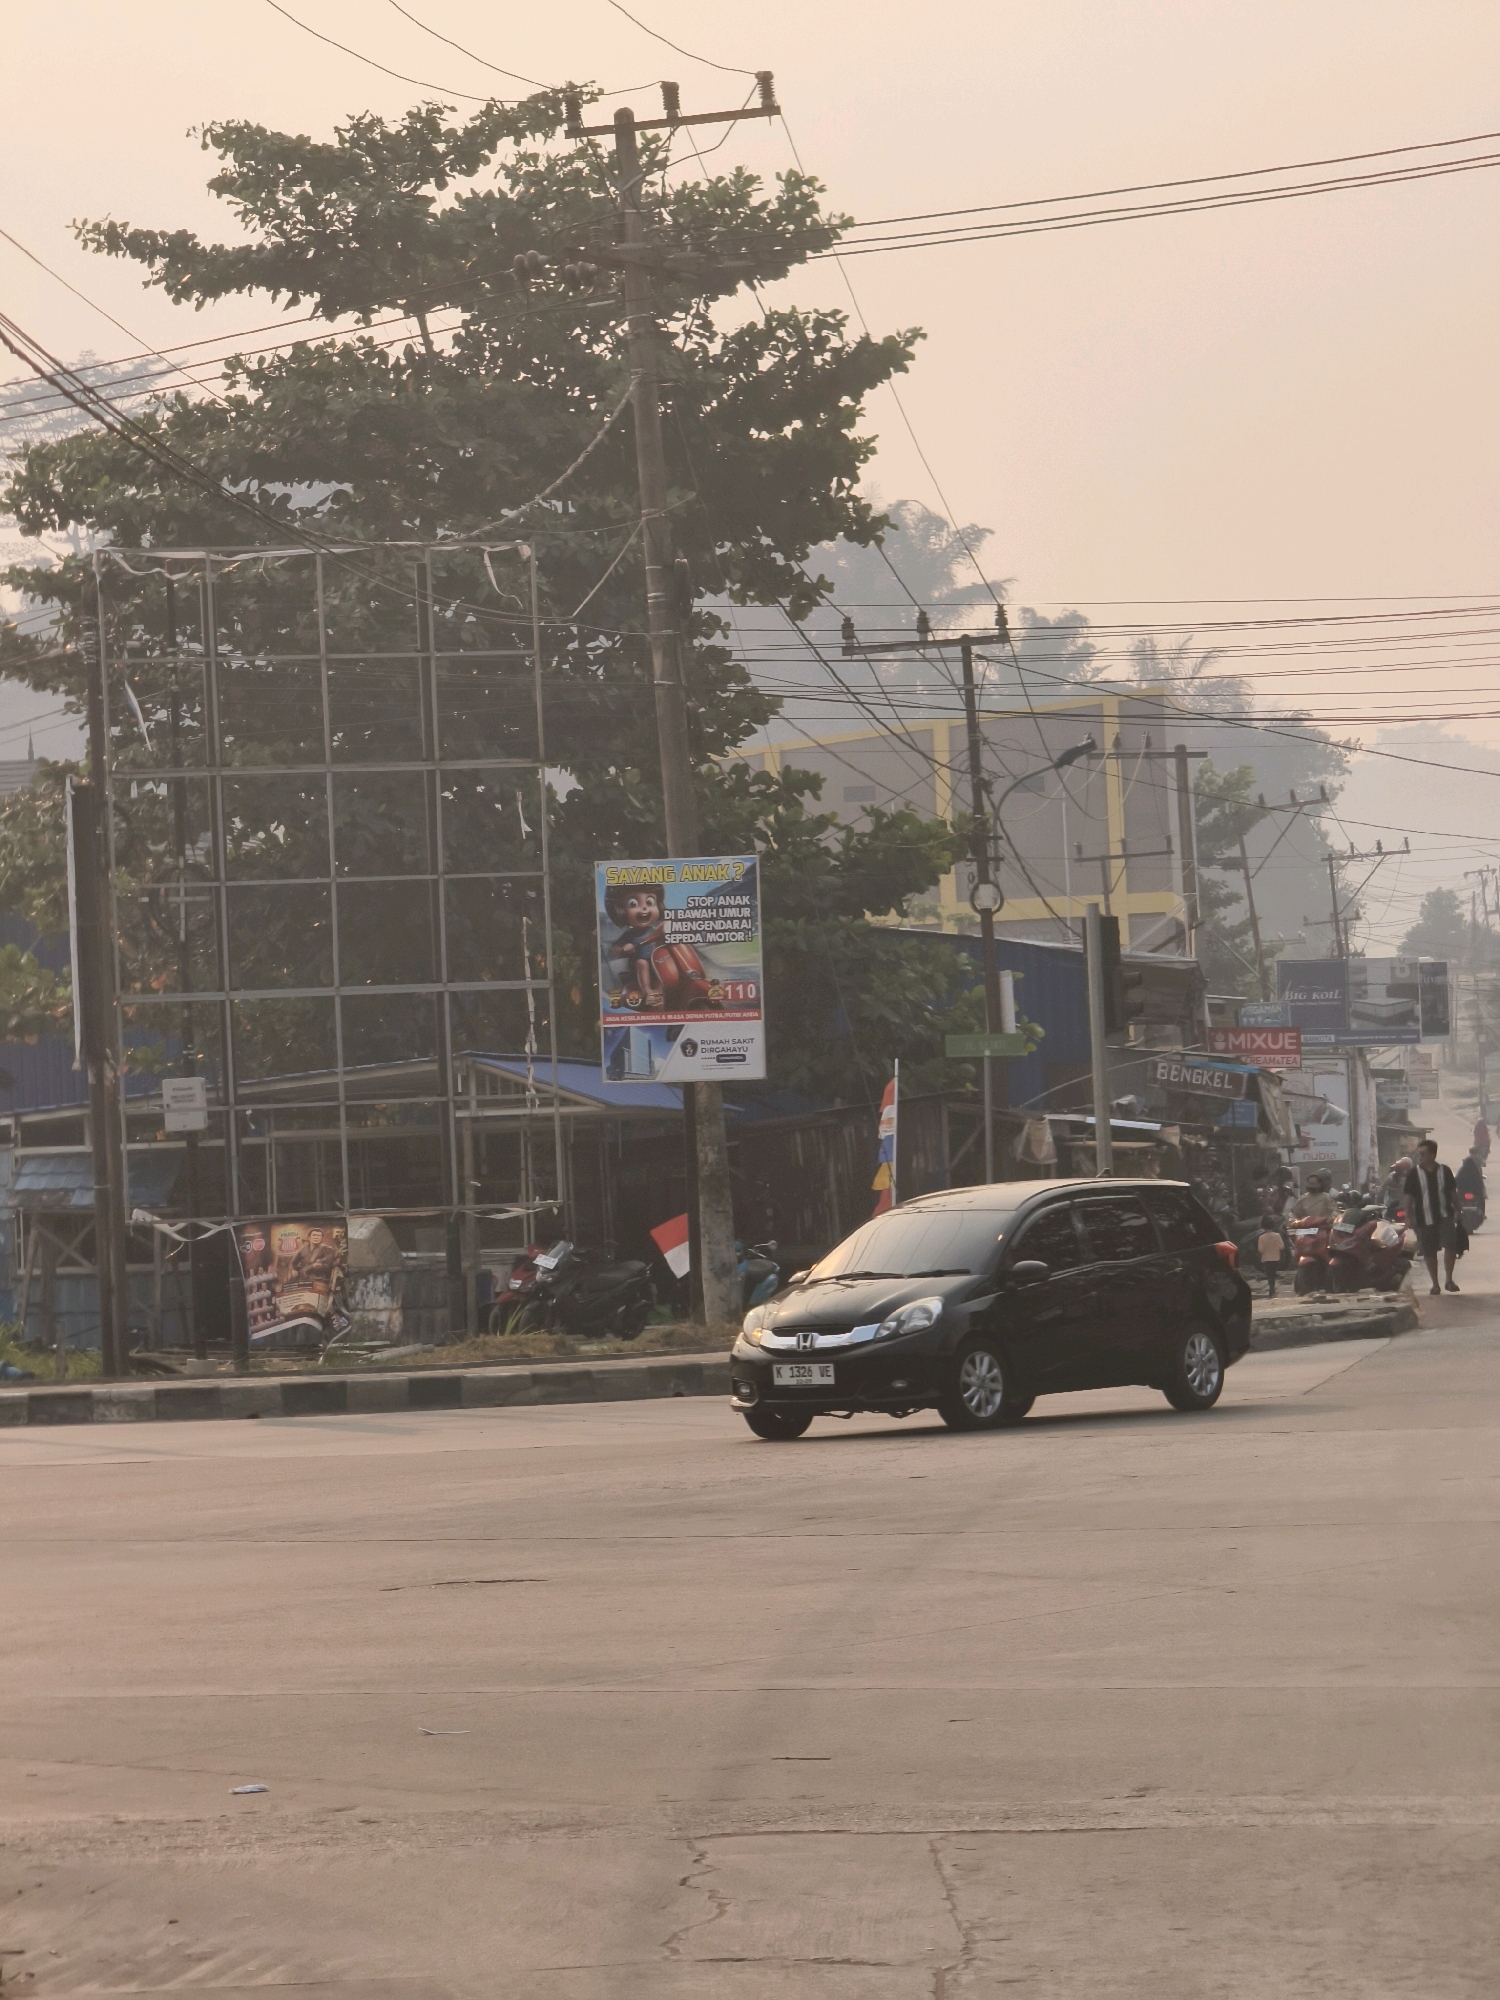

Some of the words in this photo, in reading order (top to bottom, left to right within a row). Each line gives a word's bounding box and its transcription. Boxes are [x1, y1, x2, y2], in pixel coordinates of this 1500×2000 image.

[606, 865, 676, 885] SAYANG
[680, 863, 730, 882] ANAK
[733, 862, 744, 880] ?
[687, 896, 715, 907] STOP
[717, 895, 750, 906] ANAK
[664, 910, 675, 919] DI
[677, 908, 717, 919] BAWAH
[719, 907, 751, 918] UMUR
[672, 919, 751, 932] MENGENDARAI
[664, 933, 703, 944] SEPEDA
[705, 931, 745, 942] MOTOR
[725, 983, 756, 1000] 110
[1228, 1032, 1298, 1050] MIXUE
[701, 1046, 749, 1054] DIRGAHAYU
[1156, 1062, 1233, 1089] BENGKEL
[1302, 1150, 1337, 1161] nubia
[789, 1365, 813, 1378] 1326
